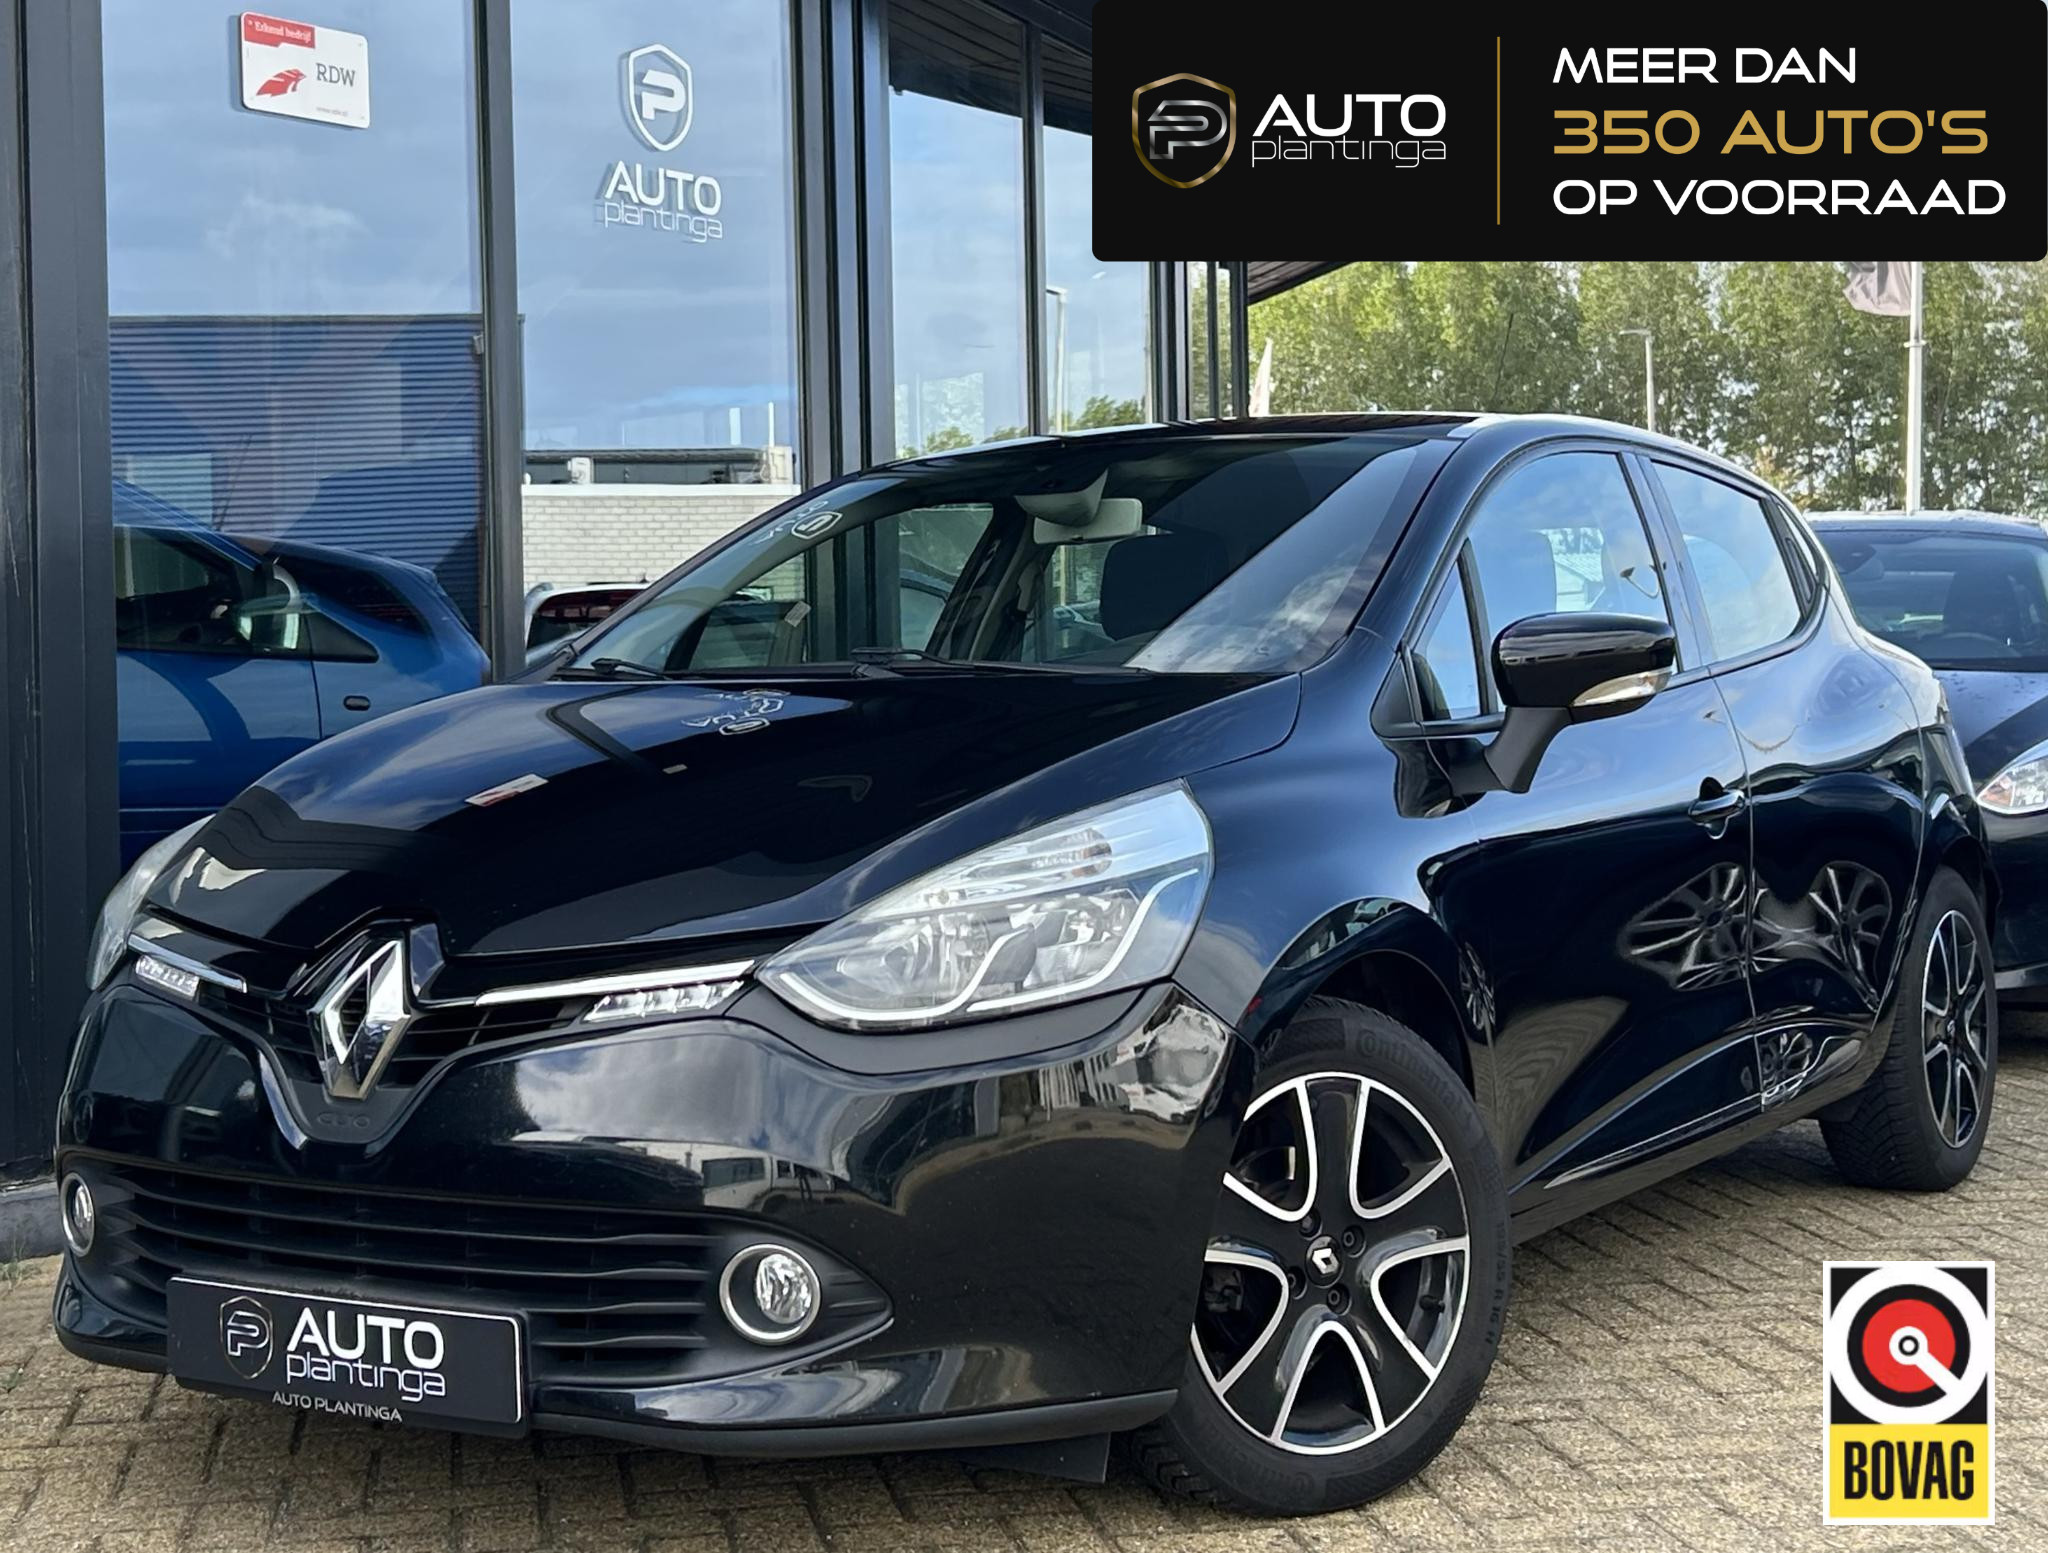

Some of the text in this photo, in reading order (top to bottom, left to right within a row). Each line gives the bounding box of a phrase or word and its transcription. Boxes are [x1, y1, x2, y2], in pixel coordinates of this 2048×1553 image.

[316, 63, 356, 87] RDW
[604, 160, 721, 216] AUTO
[604, 200, 723, 243] plantinga
[287, 1307, 444, 1369] AUTO
[286, 1352, 446, 1401] plantinga
[272, 1391, 402, 1422] AUTO PLANTINGA
